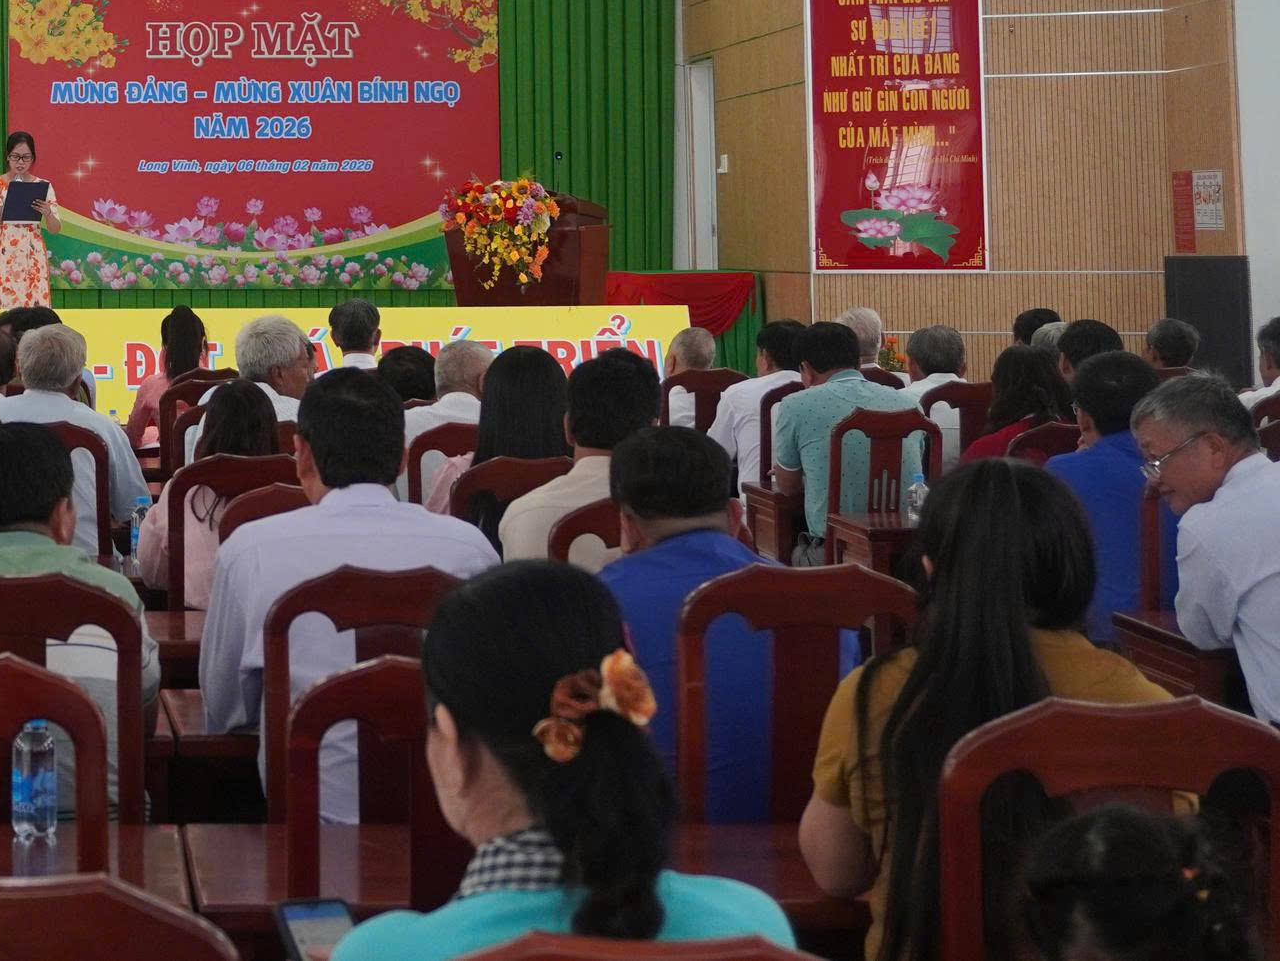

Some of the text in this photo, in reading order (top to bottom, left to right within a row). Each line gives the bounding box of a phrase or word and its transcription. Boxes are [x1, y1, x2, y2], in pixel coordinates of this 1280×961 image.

[146, 11, 360, 67] HỌP MẶT
[850, 16, 868, 46] SỰ
[831, 49, 864, 77] NHẤT
[869, 50, 889, 76] TRÍ
[50, 76, 119, 104] MỪNG
[125, 75, 188, 104] ĐẢNG
[213, 76, 282, 104] MỪNG
[288, 76, 352, 104] XUÂN
[358, 76, 409, 104] BÍNH
[414, 80, 460, 108] NGỌ
[823, 89, 848, 112] NHƯ
[852, 86, 873, 112] GIỮ
[877, 86, 898, 112] GÌN
[902, 89, 928, 111] CON
[194, 112, 312, 139] NĂM 2026
[839, 120, 865, 148] CỦA
[138, 159, 169, 174] Long
[204, 159, 236, 174] ngày
[237, 159, 254, 172] 06
[255, 159, 291, 174] tháng
[292, 159, 310, 172] 02
[311, 159, 339, 172] năm
[340, 159, 374, 172] 2026
